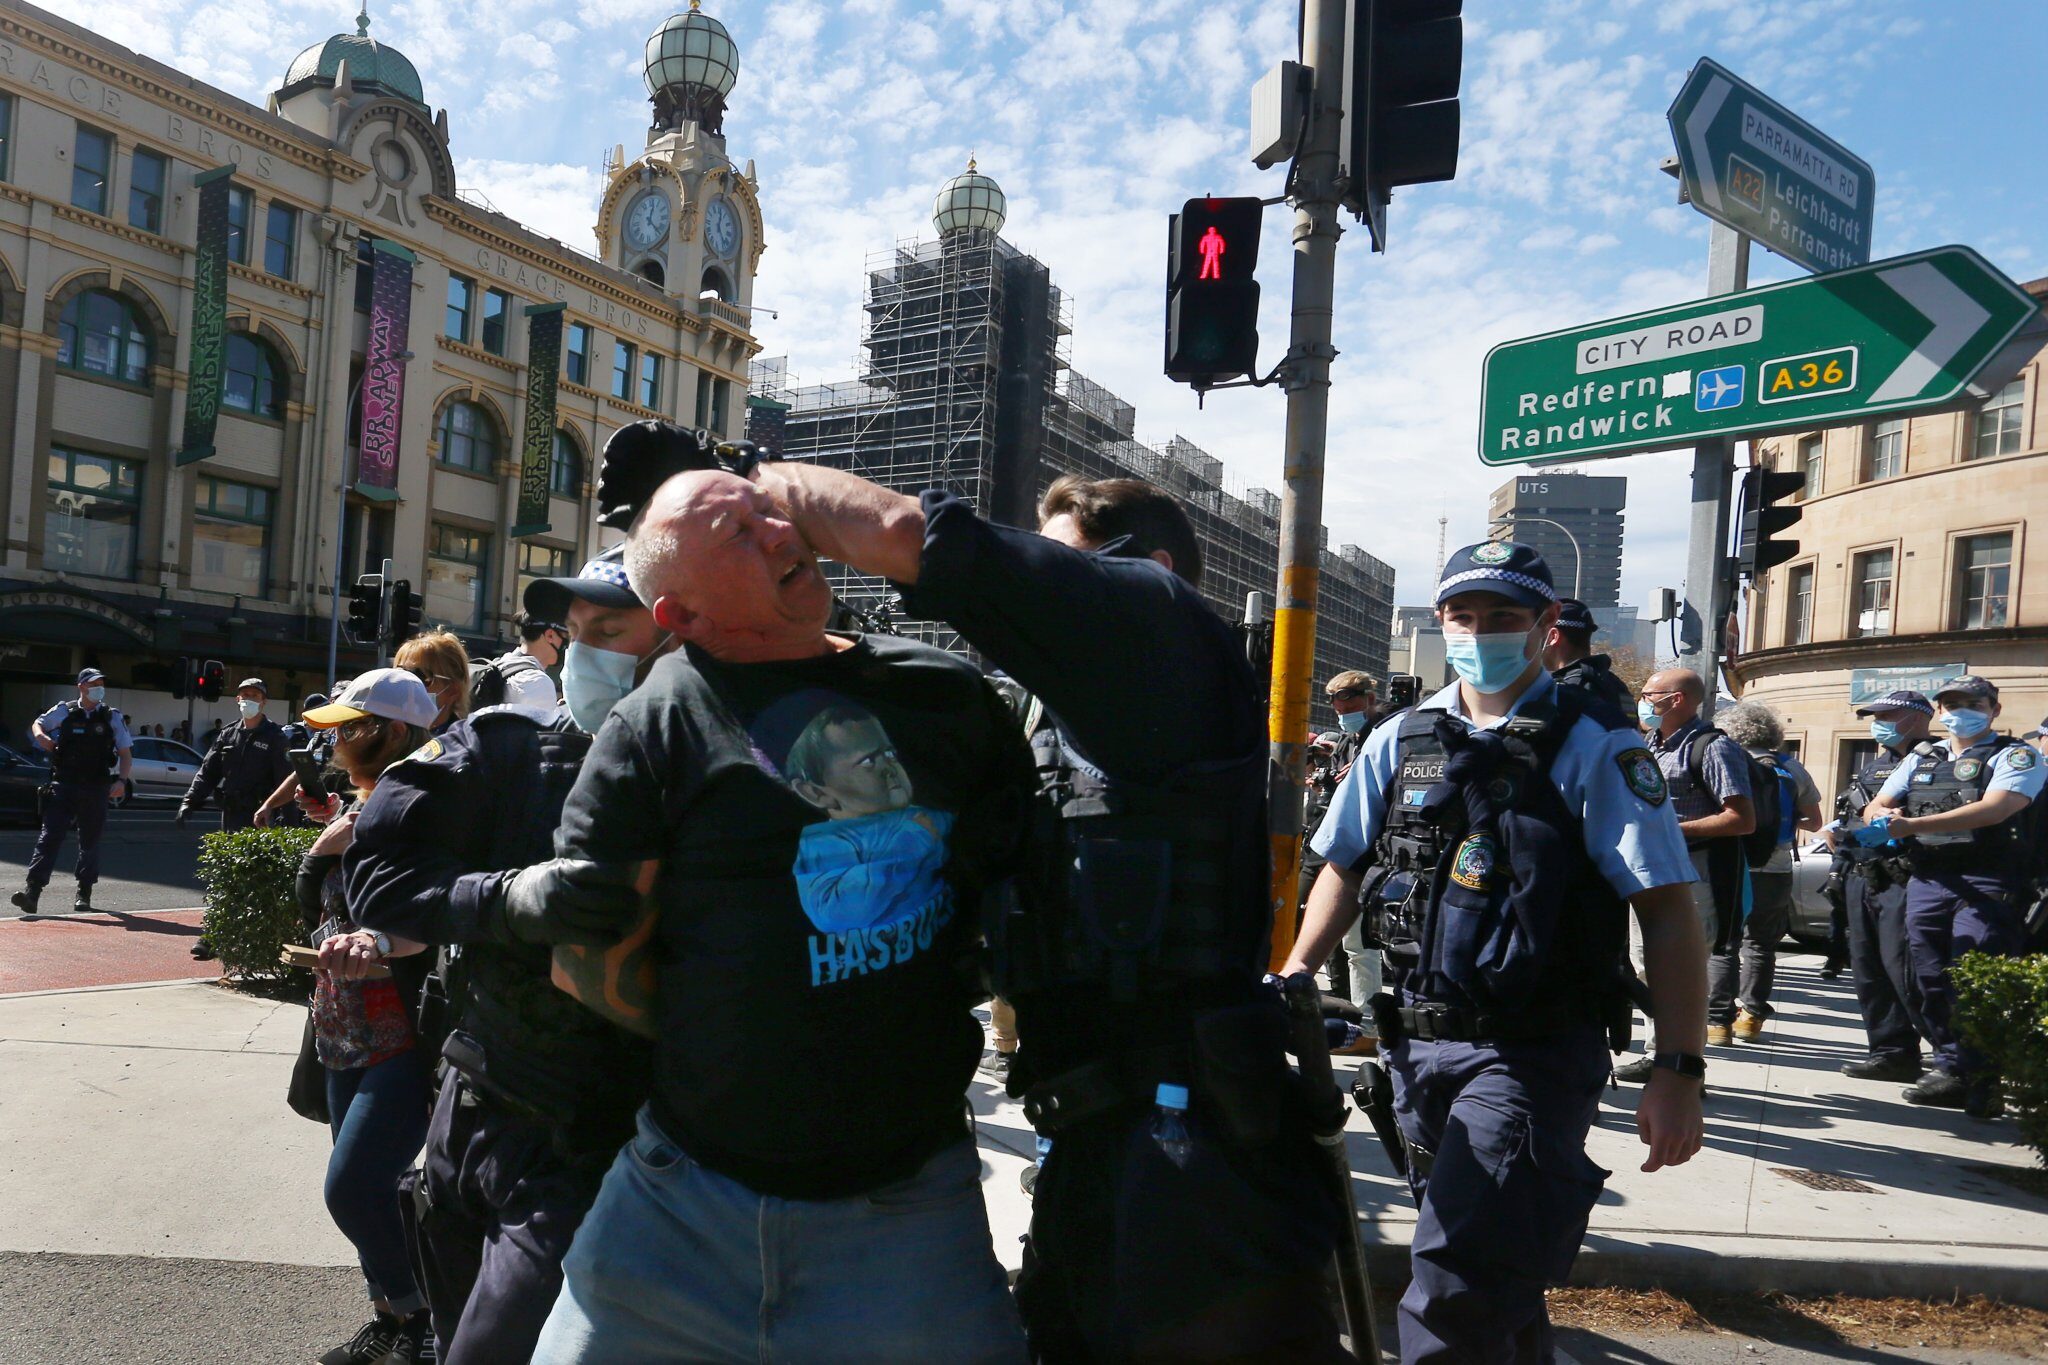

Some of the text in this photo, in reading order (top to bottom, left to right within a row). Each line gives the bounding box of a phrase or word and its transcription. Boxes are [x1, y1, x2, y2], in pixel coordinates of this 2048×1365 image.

[167, 114, 273, 180] BROS
[1746, 114, 1855, 199] PARRAMATTA RD
[1732, 167, 1762, 202] A22
[1774, 172, 1860, 246] Leichhardt
[477, 249, 648, 336] GRACE BROS
[199, 301, 224, 417] SYDNEY
[1585, 316, 1753, 365] CITY ROAD
[1518, 376, 1657, 417] Redfern
[1770, 359, 1844, 393] A36
[379, 360, 399, 467] SYDNEY
[1501, 403, 1673, 451] Randwick
[532, 410, 552, 504] SYDNEY
[1519, 482, 1549, 494] UTS
[1863, 677, 1944, 693] Mexican
[1403, 765, 1444, 778] POLICE
